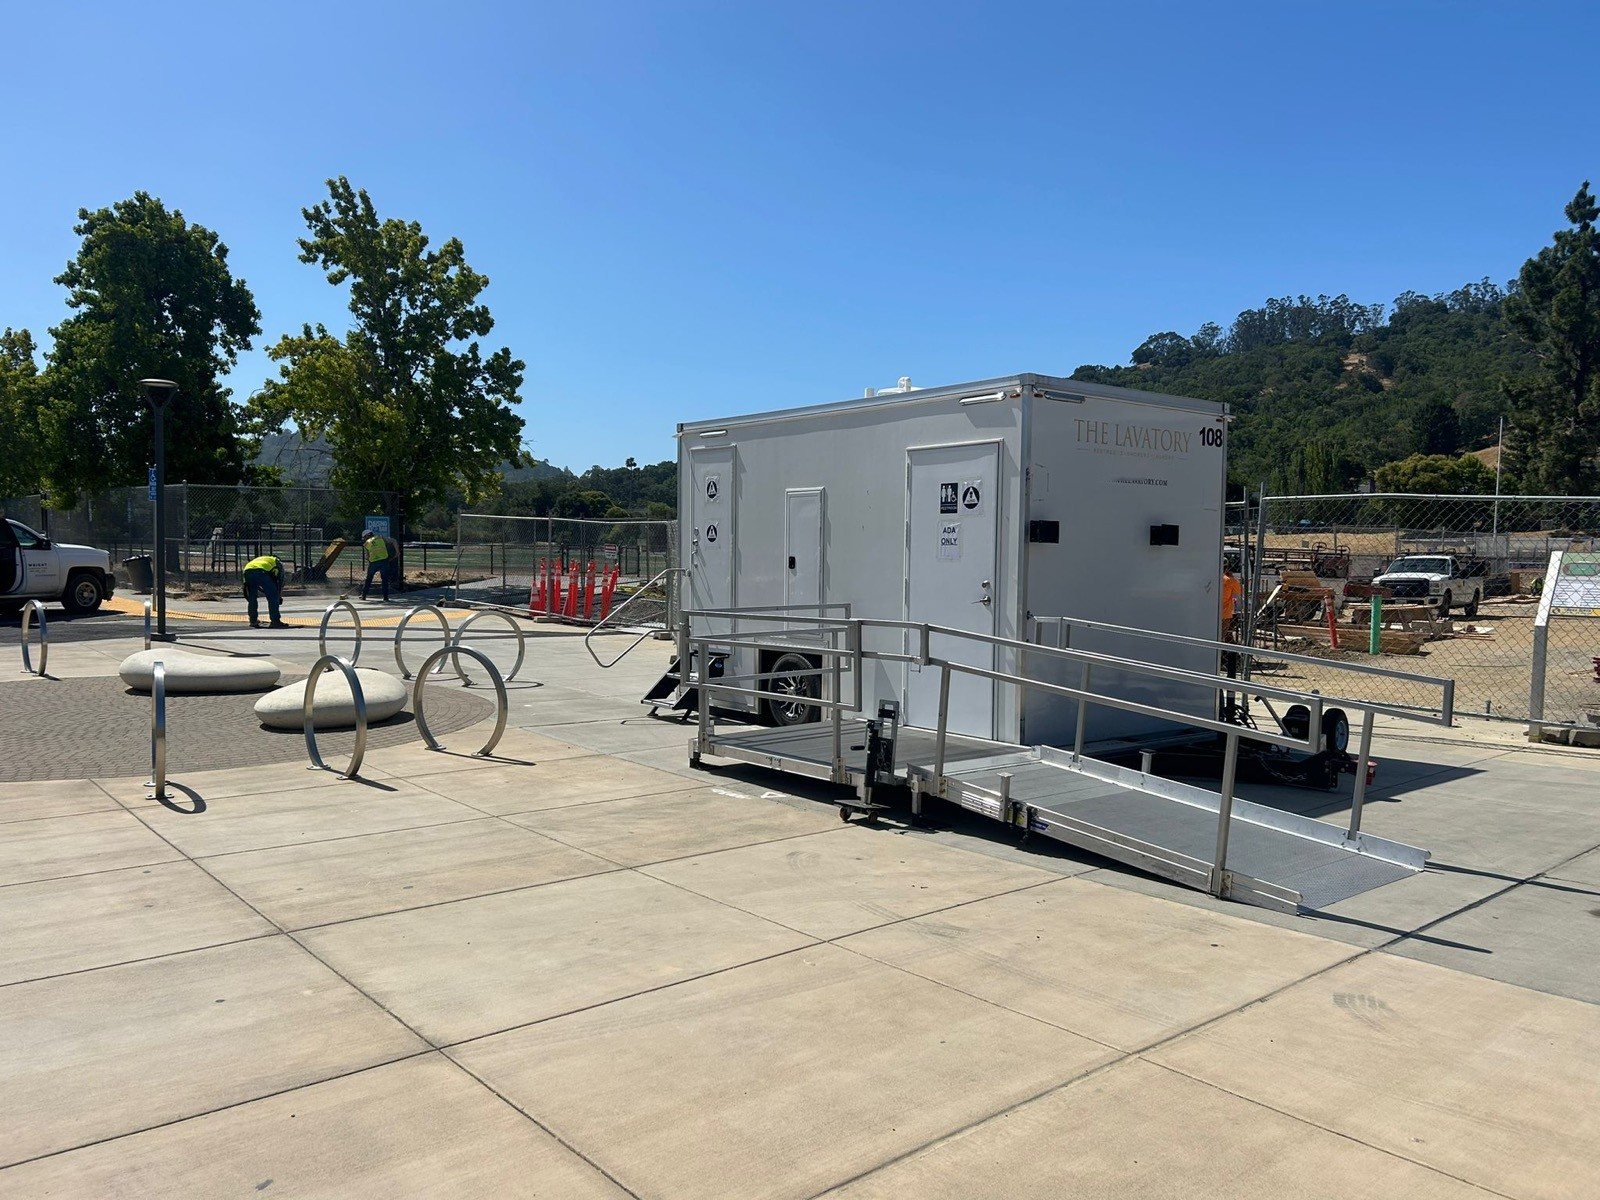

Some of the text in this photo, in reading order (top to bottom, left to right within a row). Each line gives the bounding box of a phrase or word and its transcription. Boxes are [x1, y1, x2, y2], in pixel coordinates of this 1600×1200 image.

[1074, 419, 1193, 453] THE LAVATORY
[1199, 426, 1223, 448] 108
[942, 526, 956, 534] ADA
[941, 537, 958, 545] ONLY
